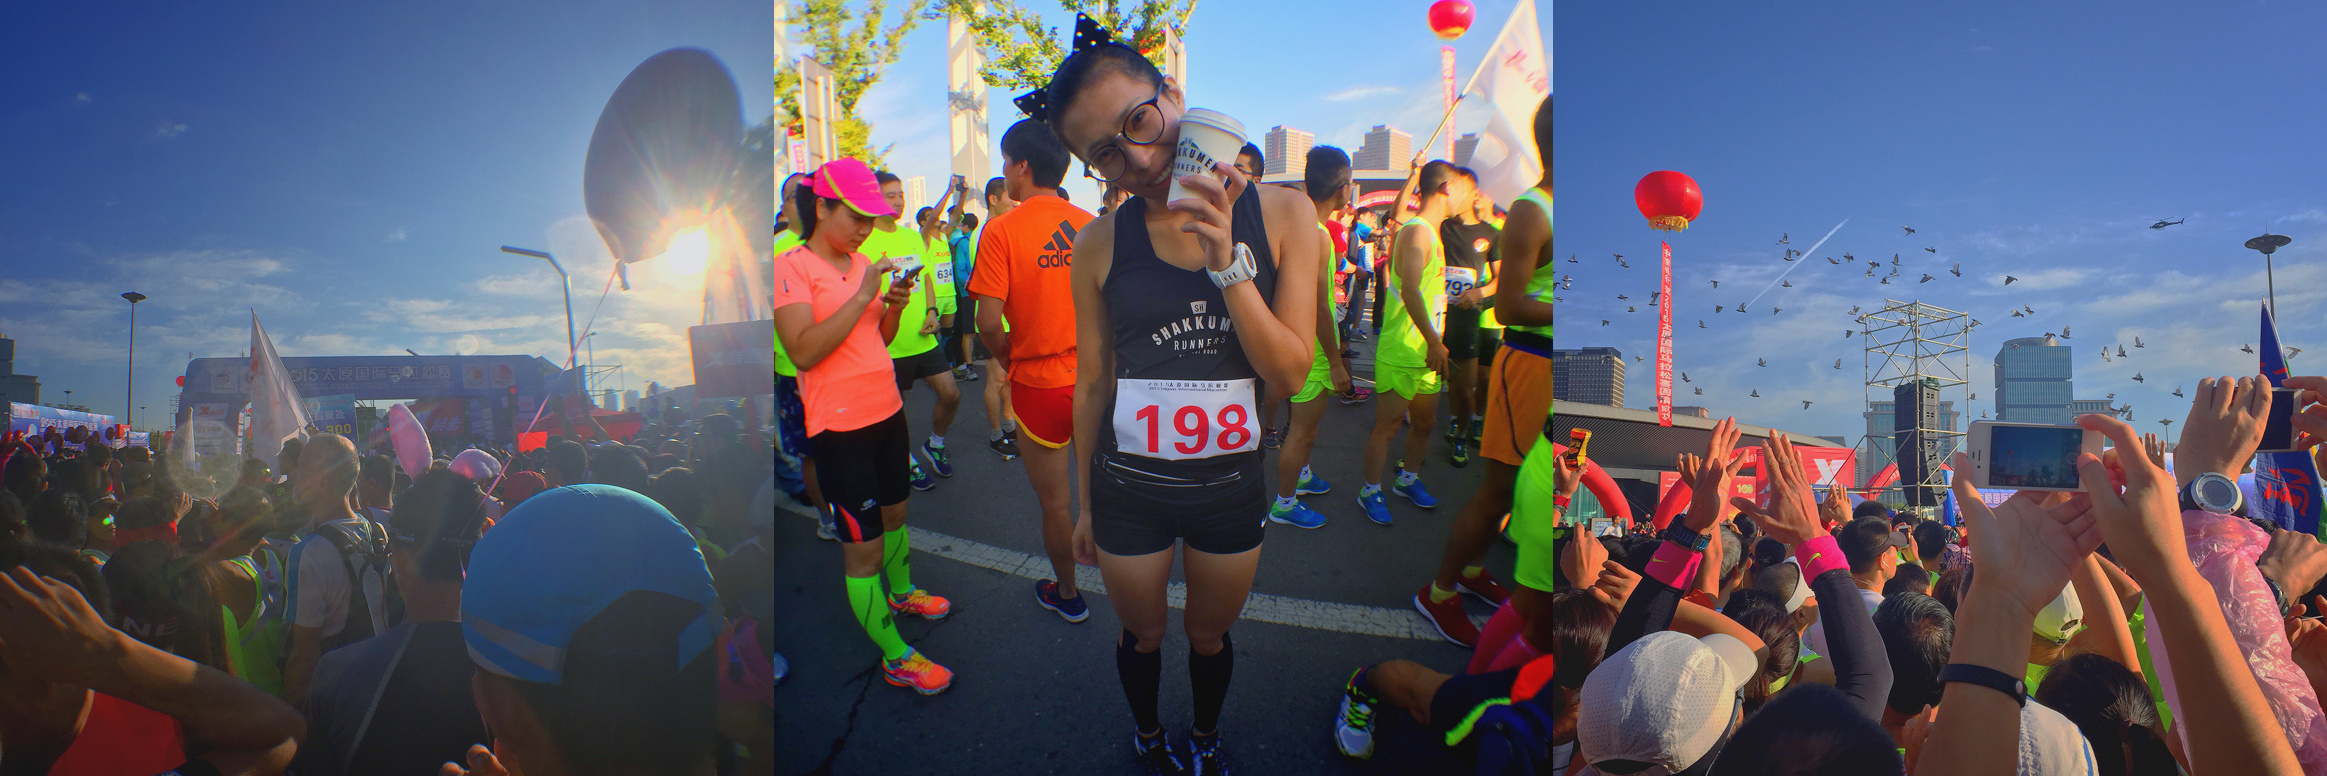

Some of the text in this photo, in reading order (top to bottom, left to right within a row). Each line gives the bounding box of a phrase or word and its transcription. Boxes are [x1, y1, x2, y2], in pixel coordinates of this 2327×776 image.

[1194, 304, 1204, 312] SH
[1152, 315, 1235, 345] SHAKKUM
[1174, 335, 1227, 351] RUNNERS
[1136, 403, 1251, 455] 198
